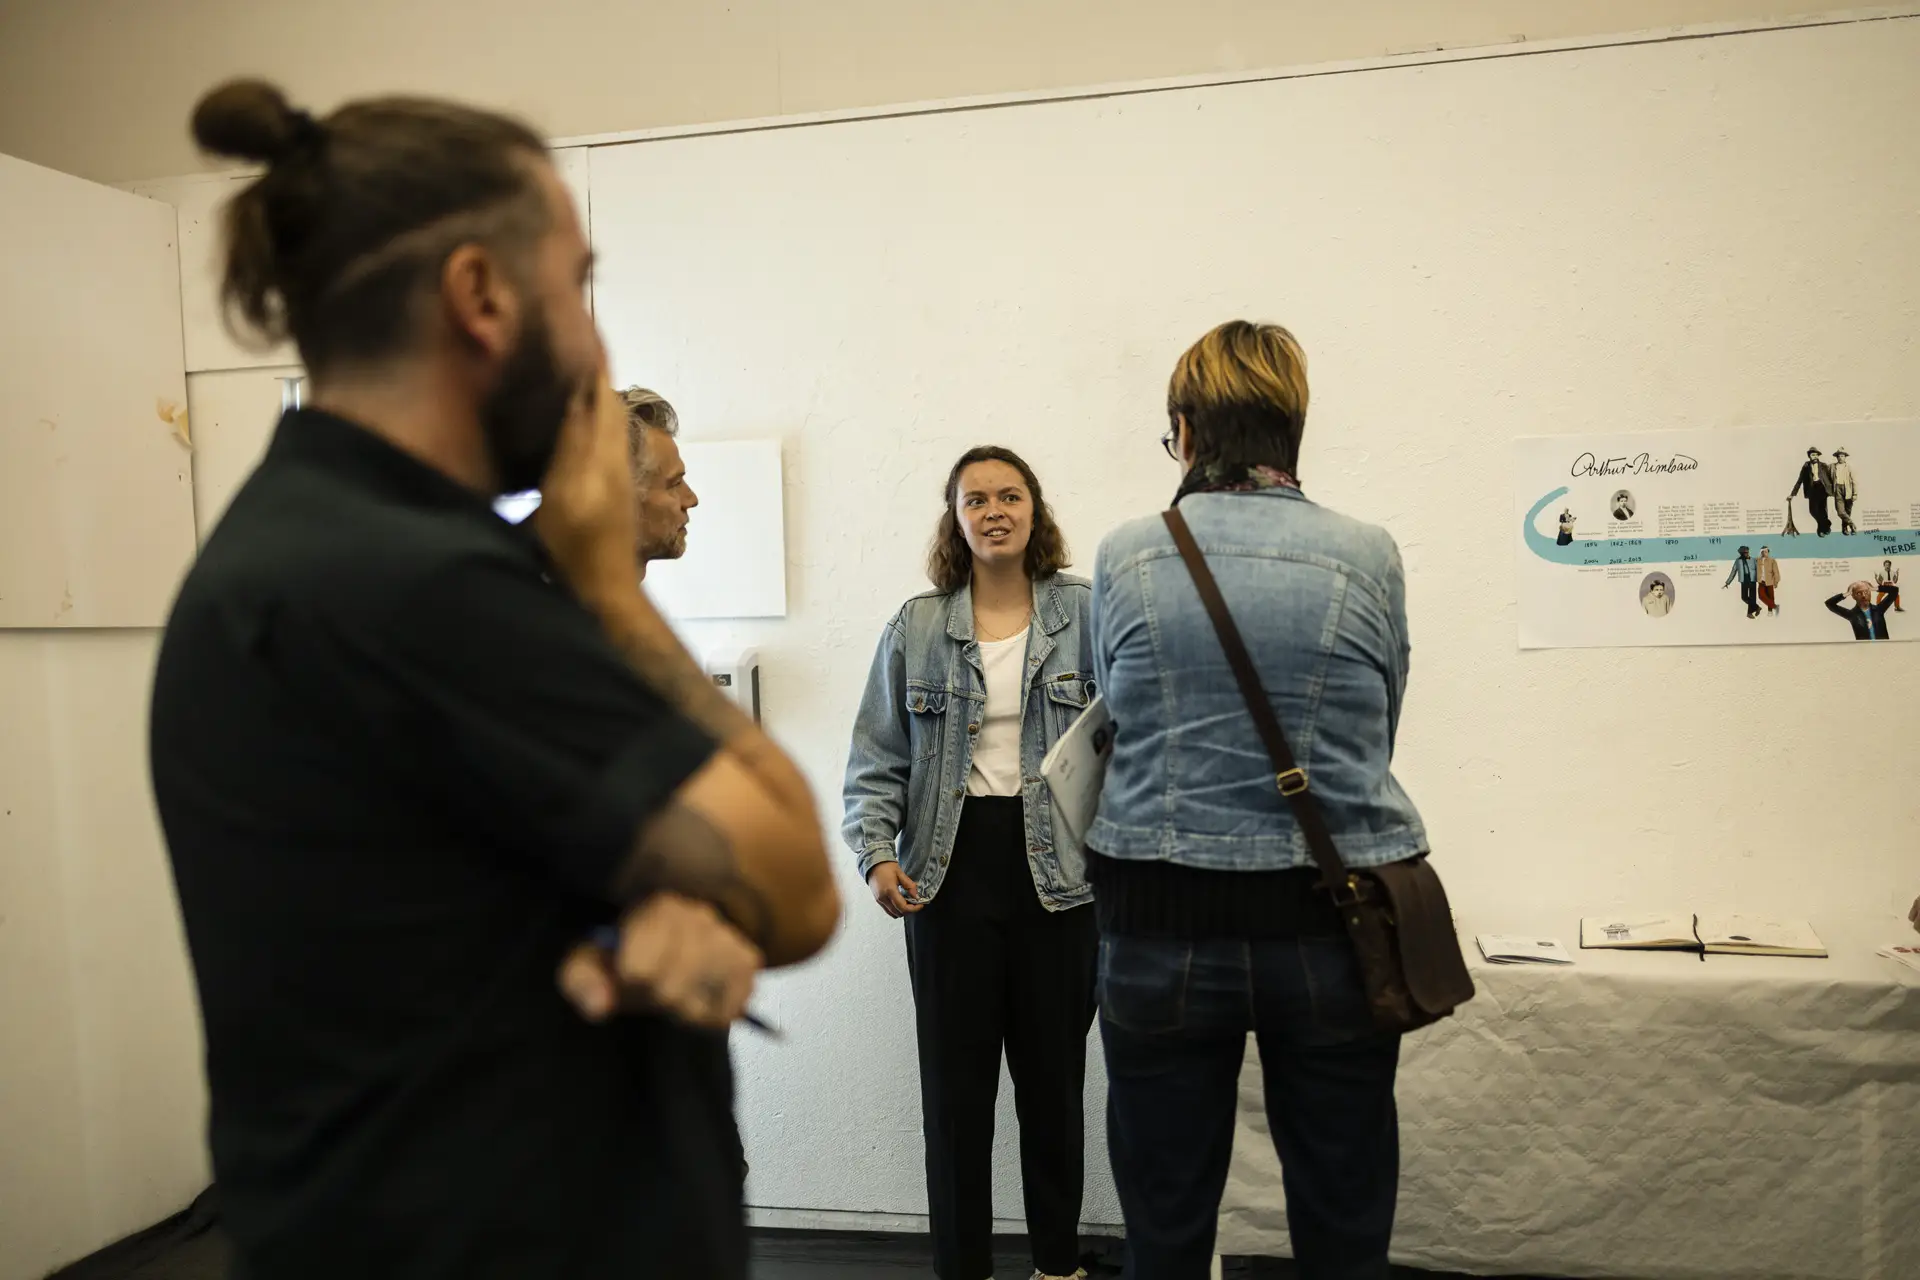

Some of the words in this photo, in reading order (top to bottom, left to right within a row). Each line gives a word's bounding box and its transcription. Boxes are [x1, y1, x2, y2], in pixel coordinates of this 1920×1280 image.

[1571, 452, 1633, 477] Arthur
[1633, 452, 1698, 475] Rimbaud
[1873, 535, 1897, 543] MERDE
[1883, 542, 1917, 555] MERDE
